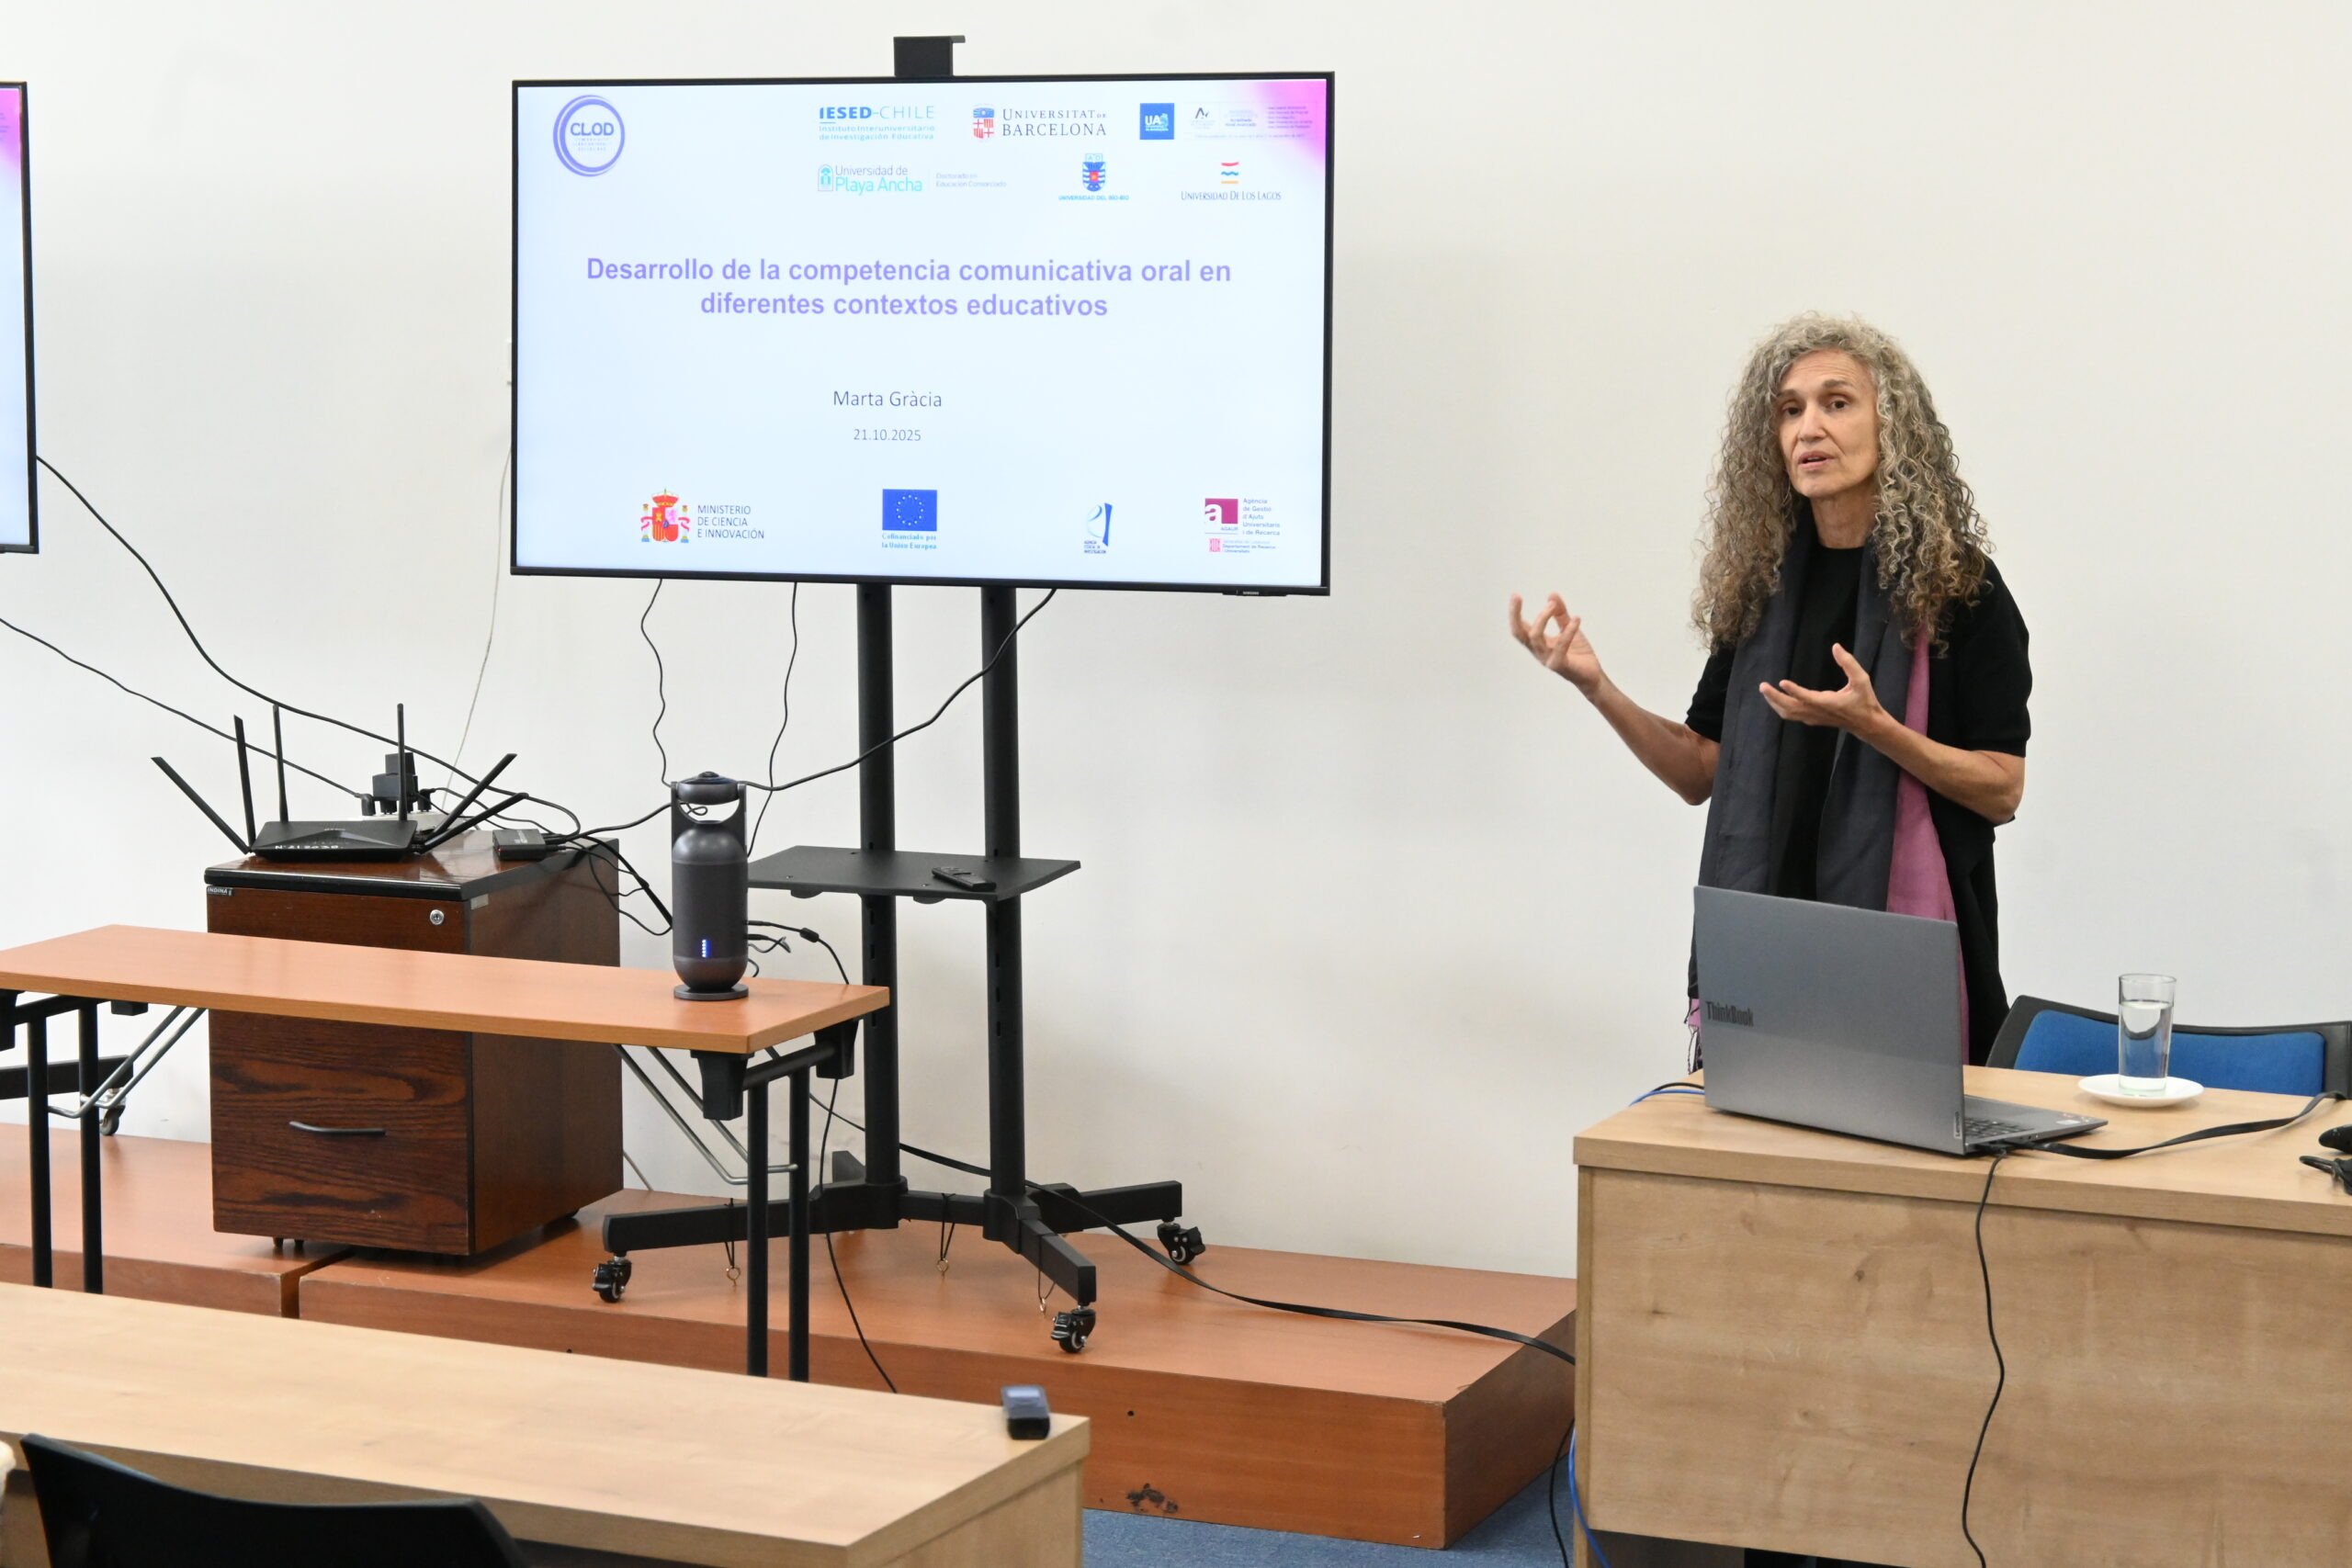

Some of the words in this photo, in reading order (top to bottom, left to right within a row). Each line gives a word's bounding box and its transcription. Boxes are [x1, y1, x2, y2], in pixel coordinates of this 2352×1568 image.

[819, 106, 935, 119] IESED-CHILE
[1002, 108, 1095, 121] UNIVERSITAT
[570, 121, 616, 137] CLOD
[1002, 123, 1108, 137] BARCELONA
[835, 165, 894, 176] Universidad
[896, 166, 908, 176] de
[835, 176, 875, 196] Playa
[877, 176, 923, 192] Ancha
[587, 257, 714, 280] Desarrollo
[721, 258, 752, 280] de
[760, 258, 781, 280] la
[788, 259, 951, 286] competencia
[958, 259, 1133, 282] comunicativa
[1141, 259, 1191, 282] oral
[1199, 264, 1232, 282] en
[700, 292, 825, 314] diferentes
[833, 294, 958, 315] contextos
[967, 294, 1108, 316] educativos
[832, 390, 884, 407] Marta
[889, 390, 943, 408] Gràcia
[853, 428, 922, 442] 21.10.2025
[697, 504, 752, 514] MINISTERIO
[697, 516, 709, 526] DE
[711, 516, 748, 527] CIENCIA
[697, 529, 703, 538] E
[705, 527, 764, 539] INNOVACIÓN
[1705, 1001, 1754, 1027] ThinkBook
